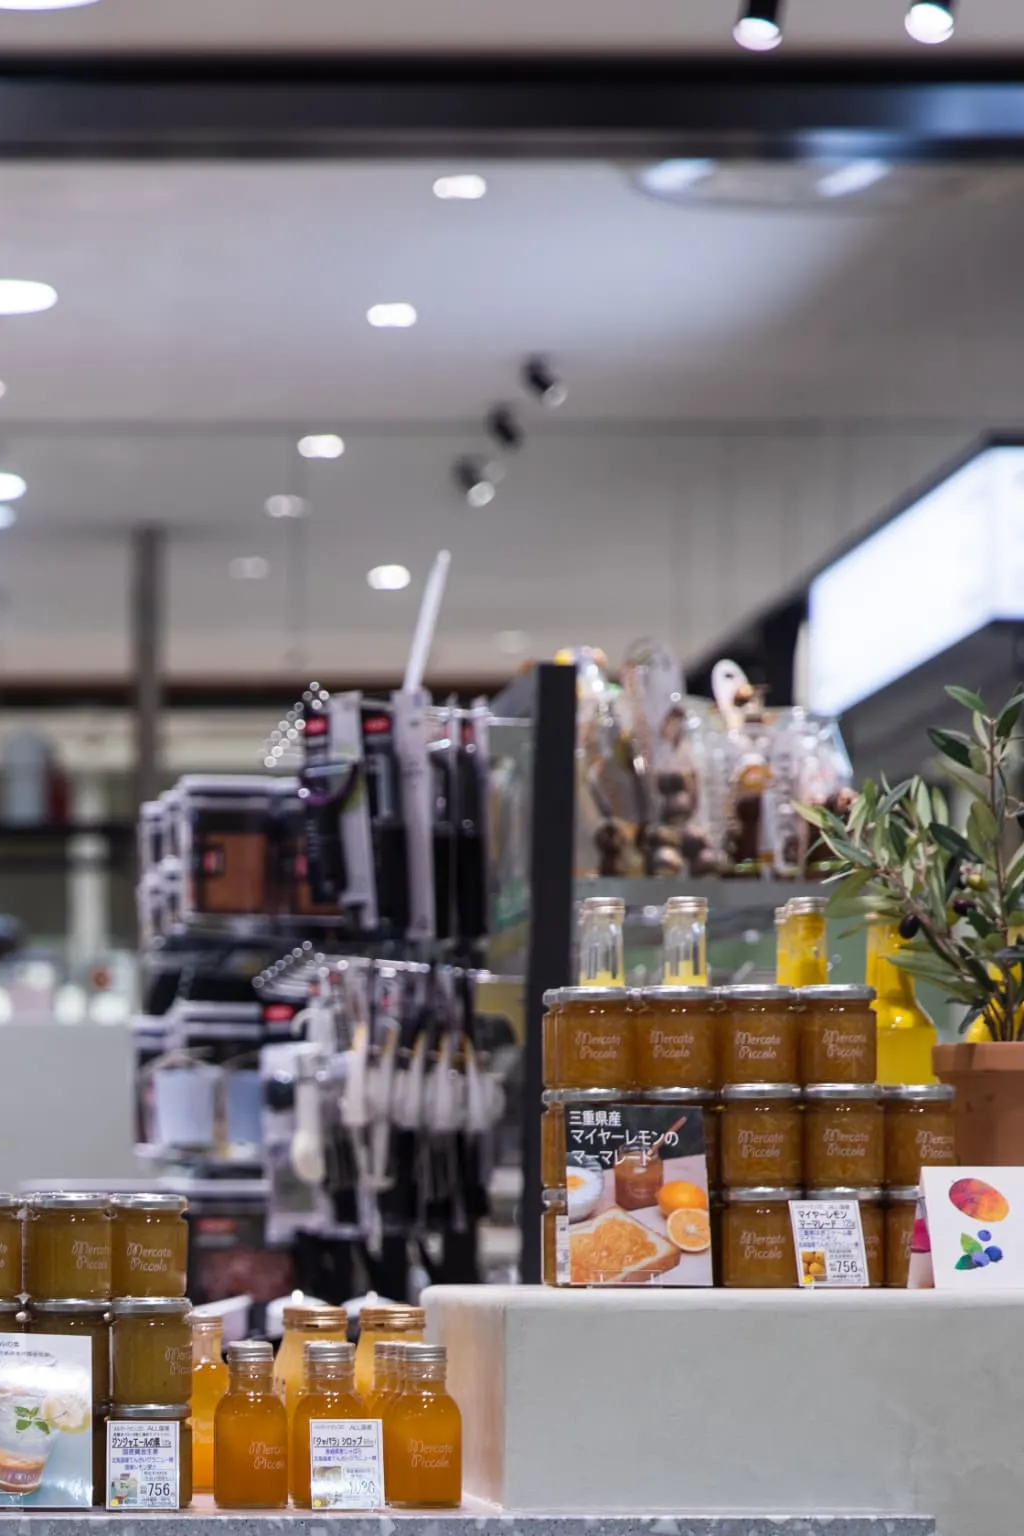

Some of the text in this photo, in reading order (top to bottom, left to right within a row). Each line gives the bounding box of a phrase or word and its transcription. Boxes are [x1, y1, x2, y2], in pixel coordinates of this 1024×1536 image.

[576, 1029, 621, 1045] Mercato
[650, 1029, 695, 1044] Mercato
[735, 1030, 781, 1045] Mercato
[580, 1045, 617, 1059] Piccolo
[653, 1044, 690, 1058] Piccolo
[739, 1045, 776, 1059] Piccolo
[568, 1110, 622, 1126] 三重県産
[570, 1128, 680, 1146] マイヤーレモンの
[737, 1128, 784, 1144] Mercato
[823, 1128, 869, 1143] Mercato
[741, 1144, 781, 1158] Piccolo
[827, 1143, 866, 1157] Piccolo
[572, 1149, 651, 1168] マーマレード
[798, 1210, 847, 1219] マイヤーレモン
[799, 1220, 836, 1229] マーマレード
[127, 1241, 172, 1257] Mercato
[130, 1257, 167, 1272] Piccolo
